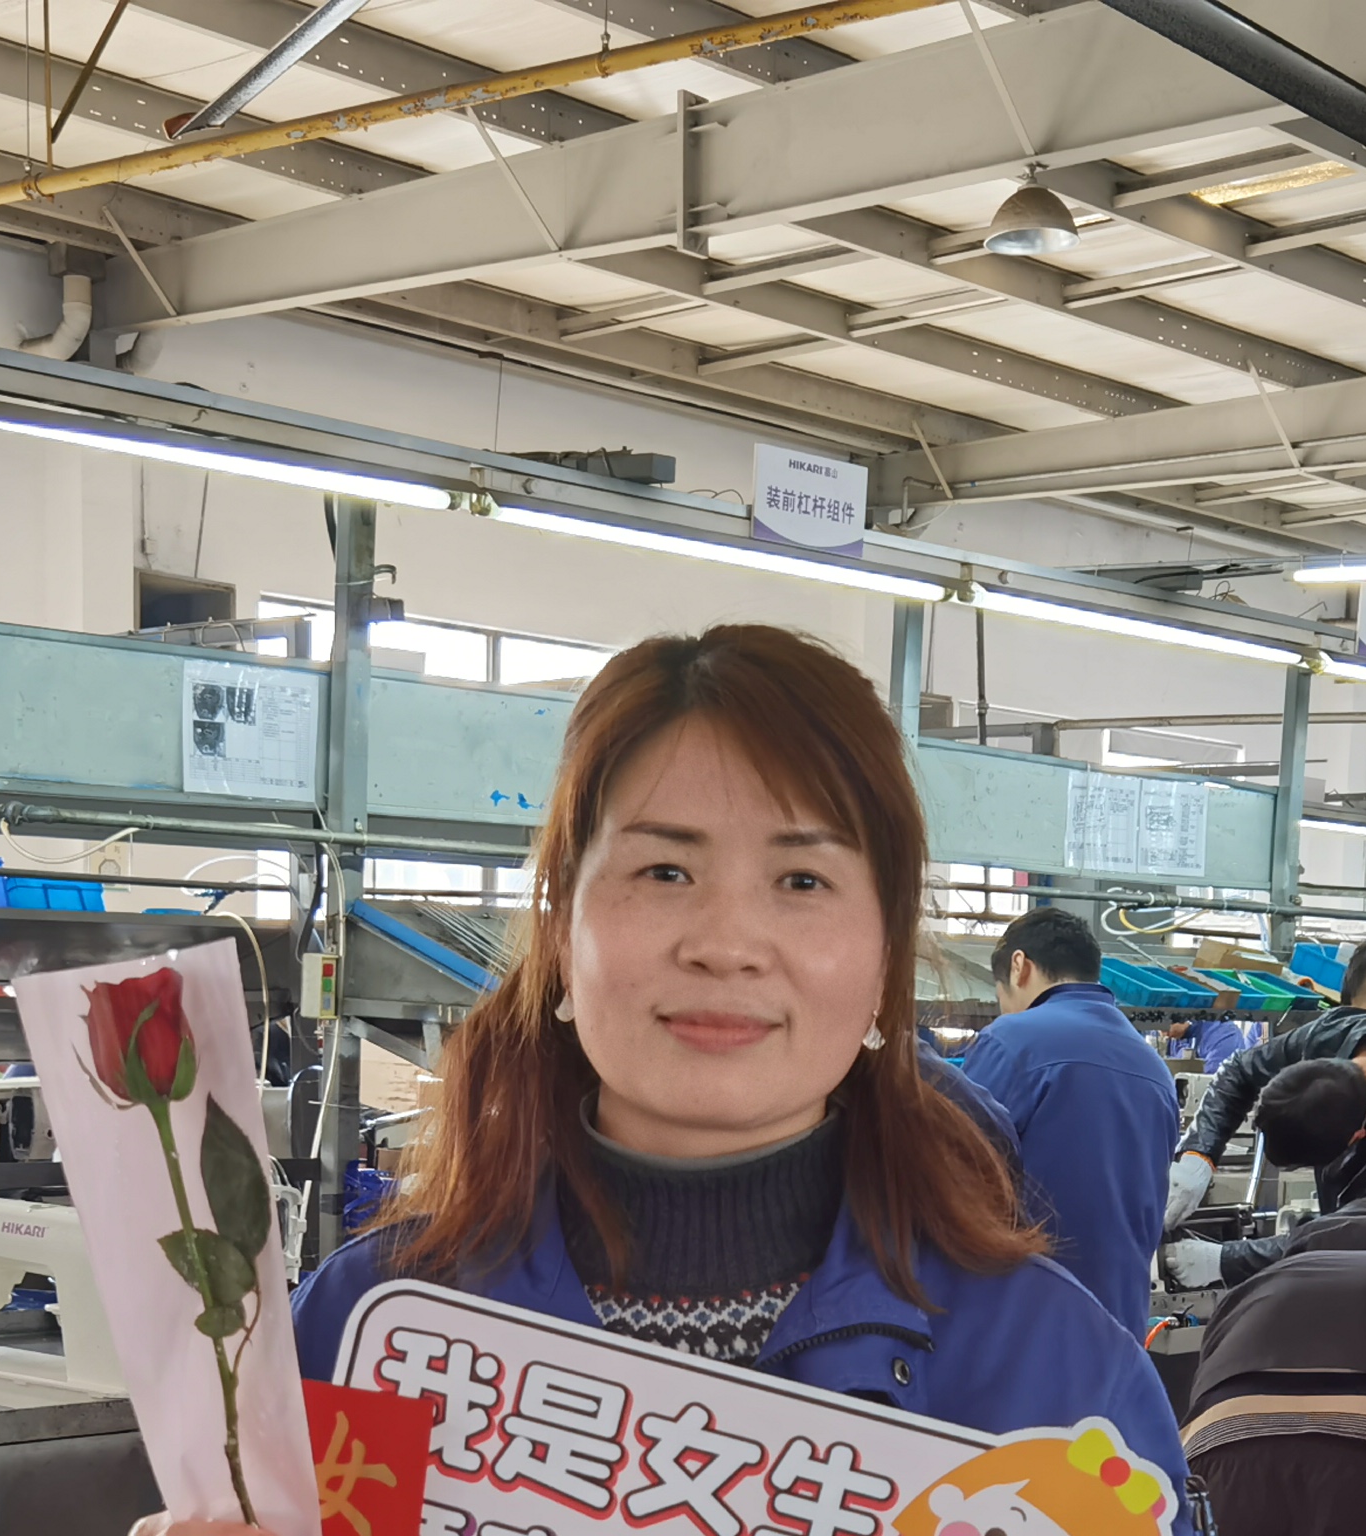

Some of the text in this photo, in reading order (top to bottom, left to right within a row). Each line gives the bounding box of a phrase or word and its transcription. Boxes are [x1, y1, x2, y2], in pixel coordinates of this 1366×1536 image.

[788, 459, 823, 475] HIKARI
[766, 485, 855, 525] 装前杠杆组件
[1, 1221, 46, 1238] HIKARI
